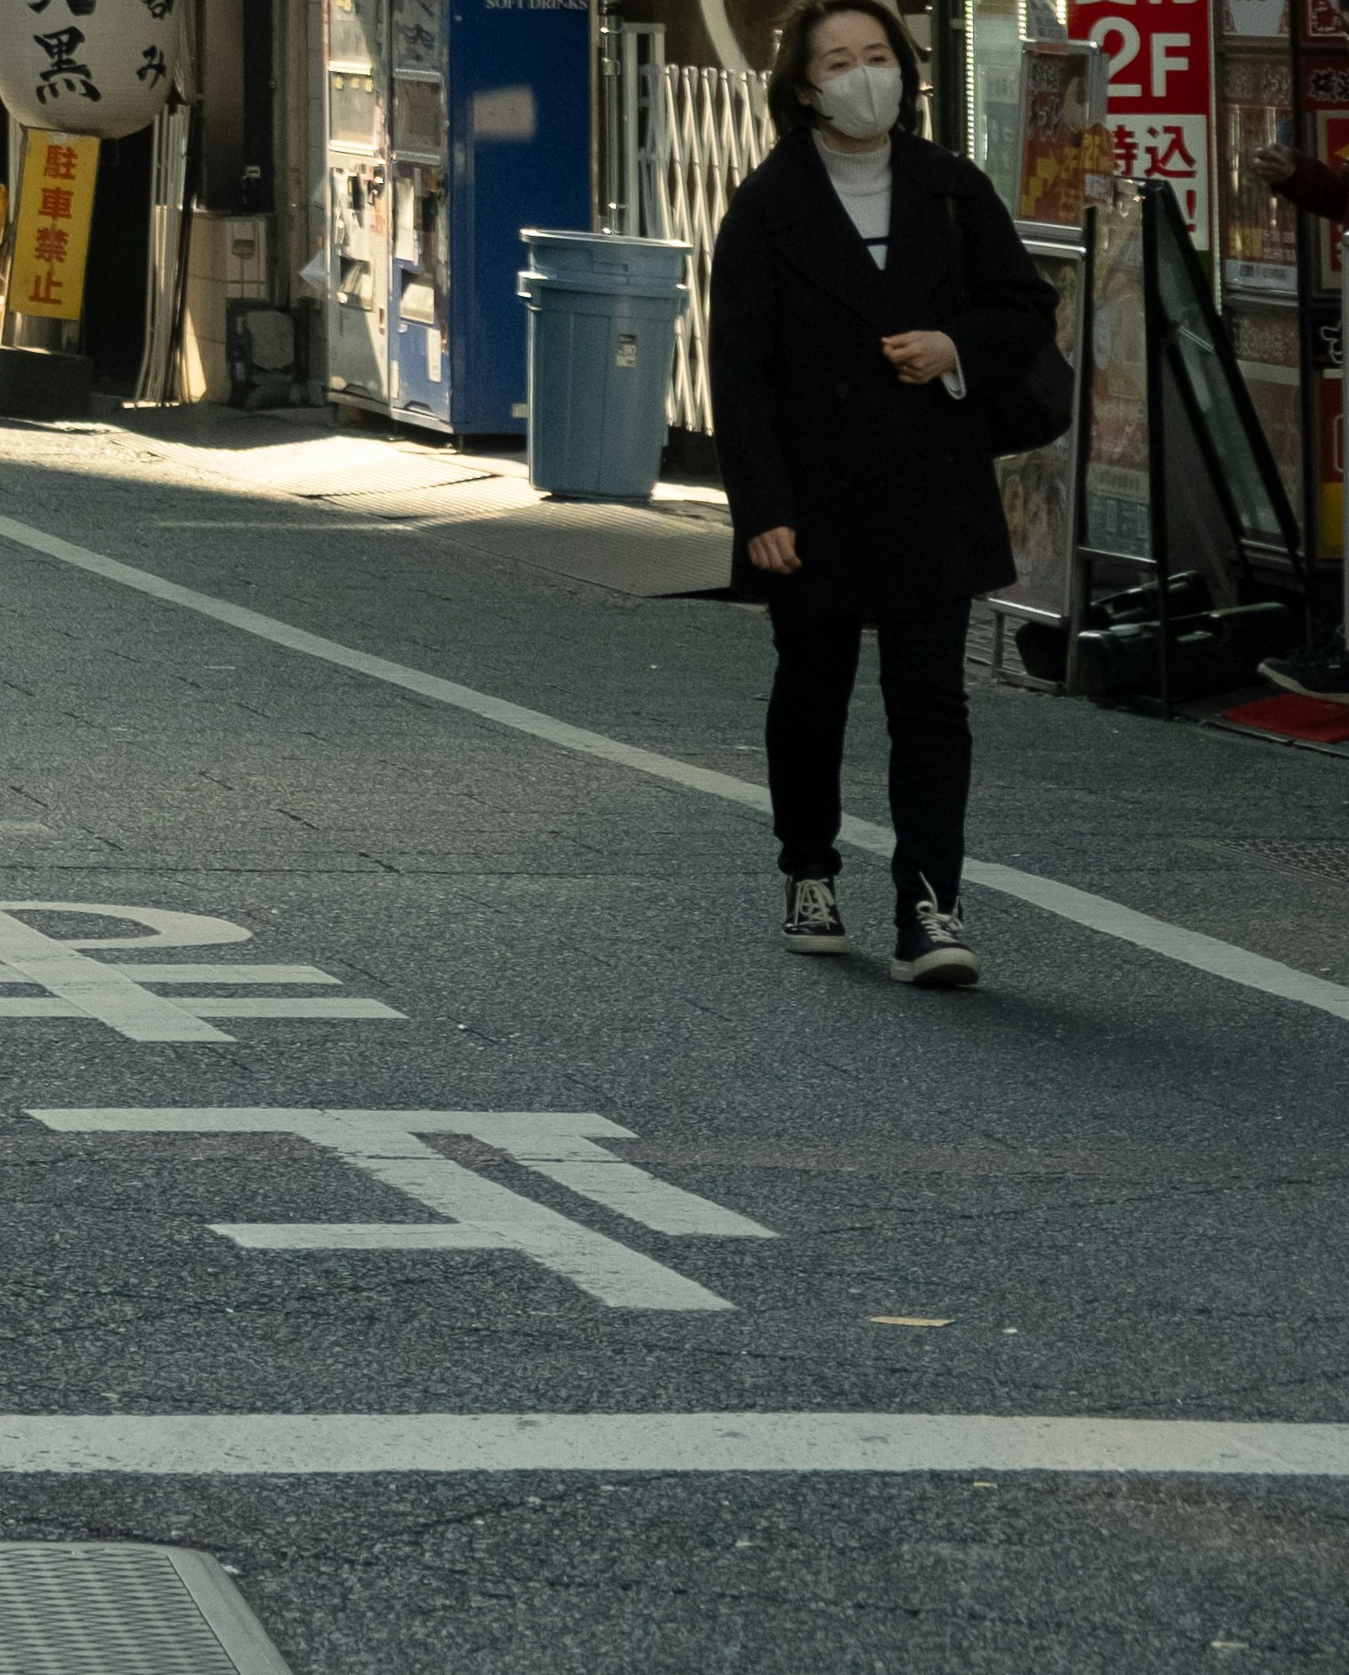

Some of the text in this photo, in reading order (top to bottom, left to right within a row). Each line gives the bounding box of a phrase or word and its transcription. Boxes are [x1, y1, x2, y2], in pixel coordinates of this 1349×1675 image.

[1091, 16, 1191, 99] 2F
[28, 141, 78, 308] 駐車禁止
